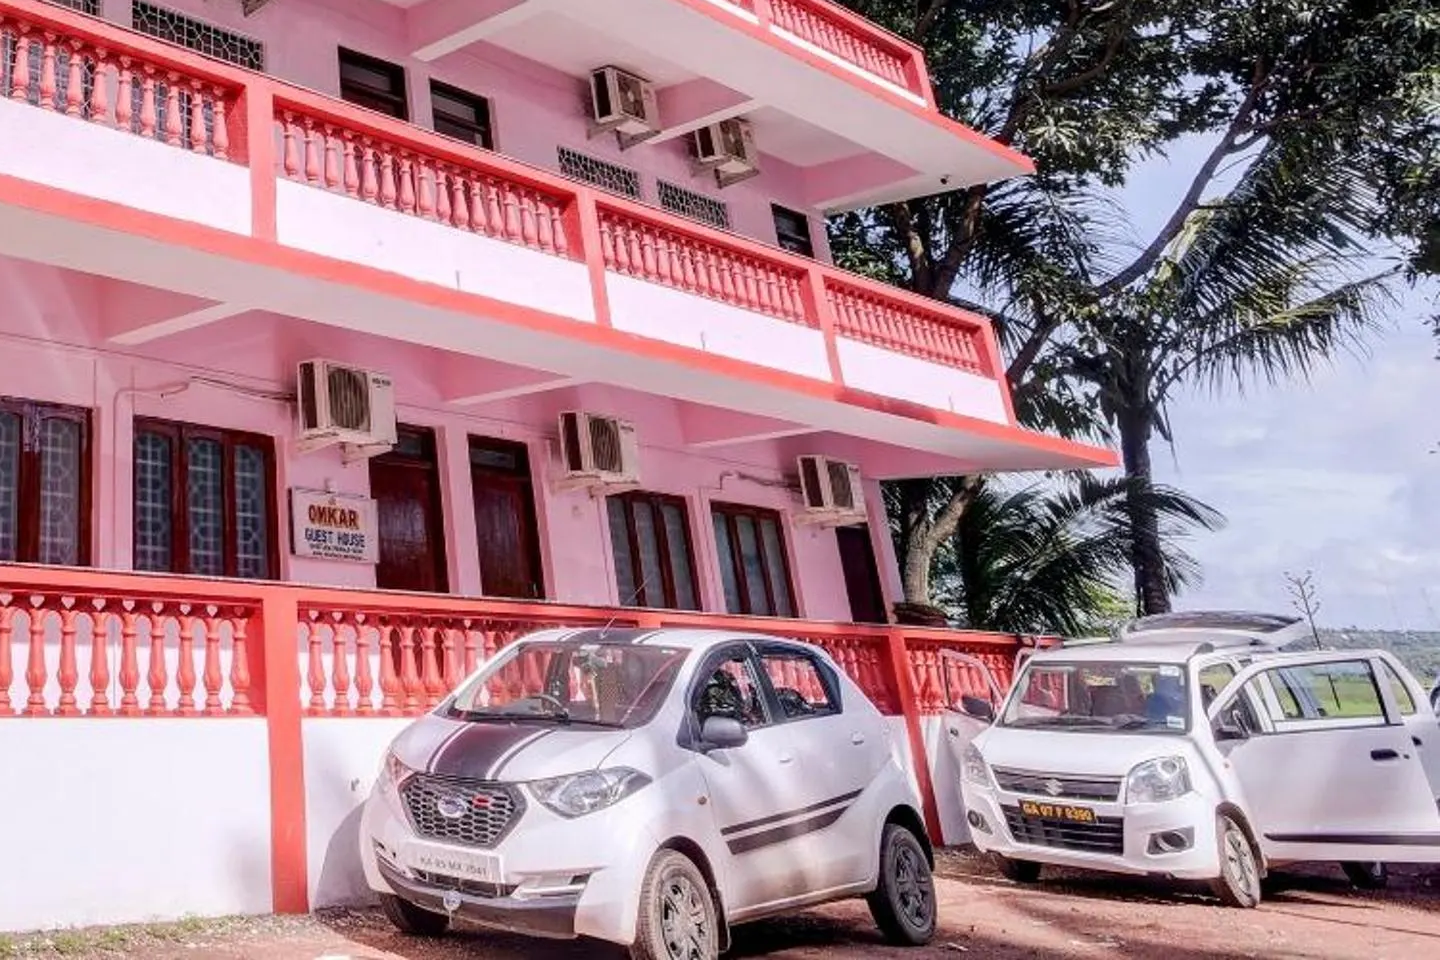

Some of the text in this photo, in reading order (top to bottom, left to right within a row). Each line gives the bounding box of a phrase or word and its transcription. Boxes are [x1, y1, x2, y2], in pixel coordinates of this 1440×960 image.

[308, 504, 359, 529] OMKAR
[305, 528, 333, 543] GUEST
[338, 531, 365, 548] HOUSE
